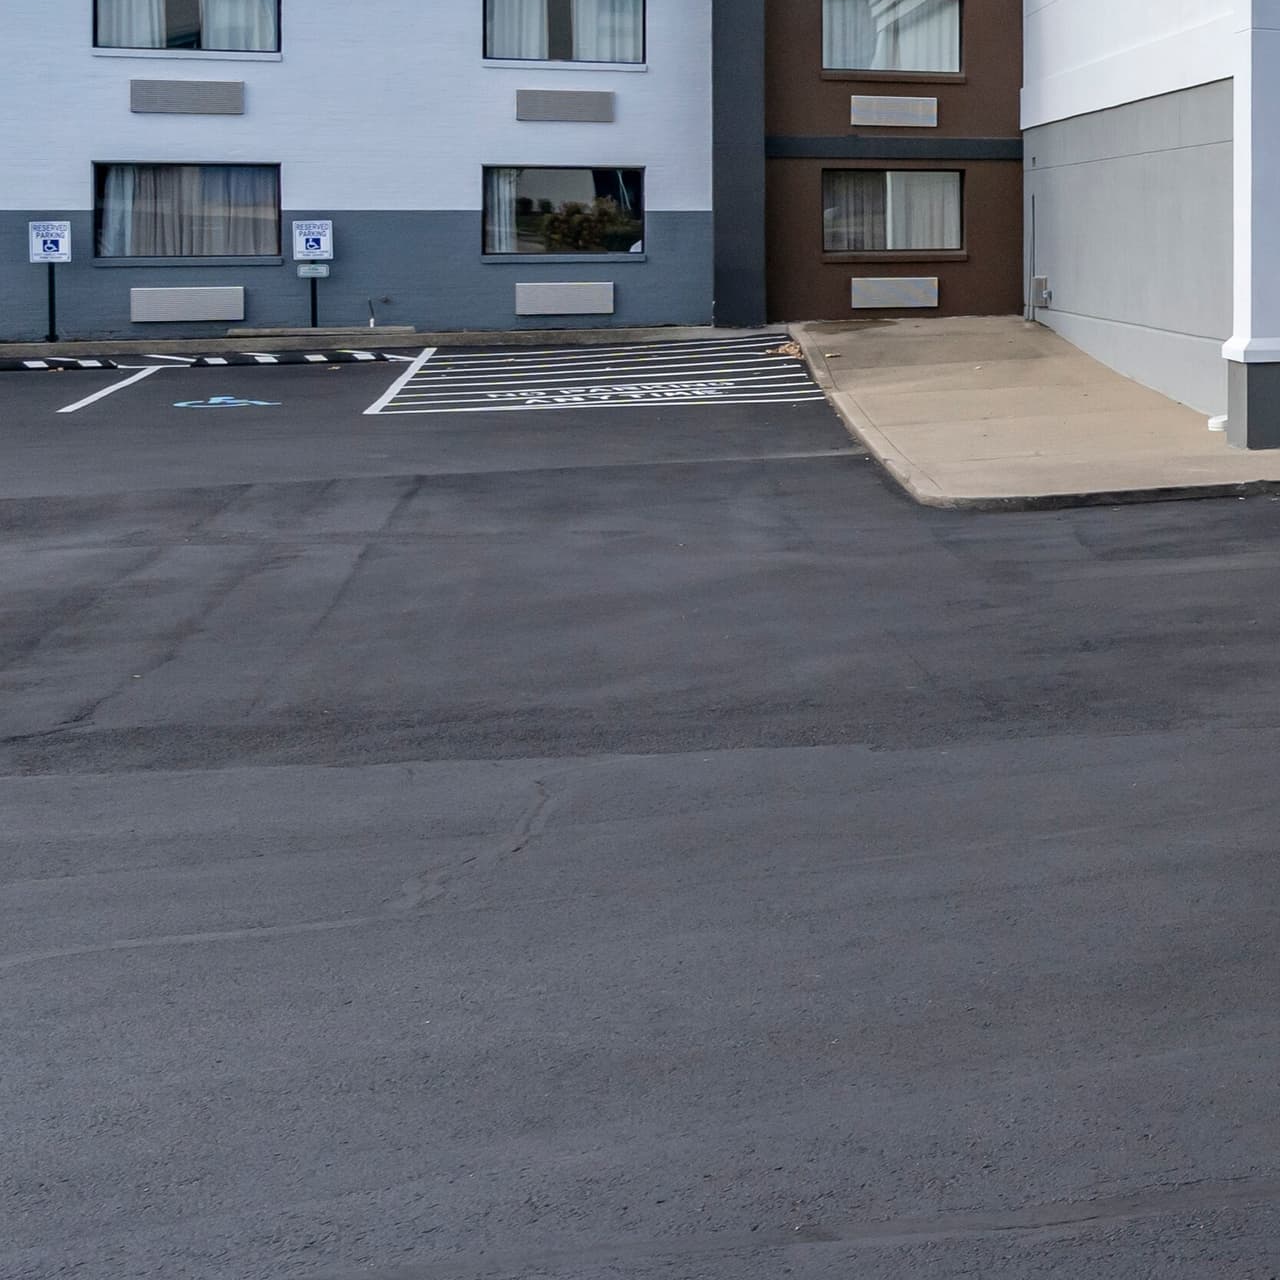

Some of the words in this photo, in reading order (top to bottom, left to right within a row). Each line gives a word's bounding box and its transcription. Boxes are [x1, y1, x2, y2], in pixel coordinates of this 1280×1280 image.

[35, 231, 65, 239] PARKING
[559, 382, 735, 394] PARKING
[525, 390, 725, 404] ANYTIME
